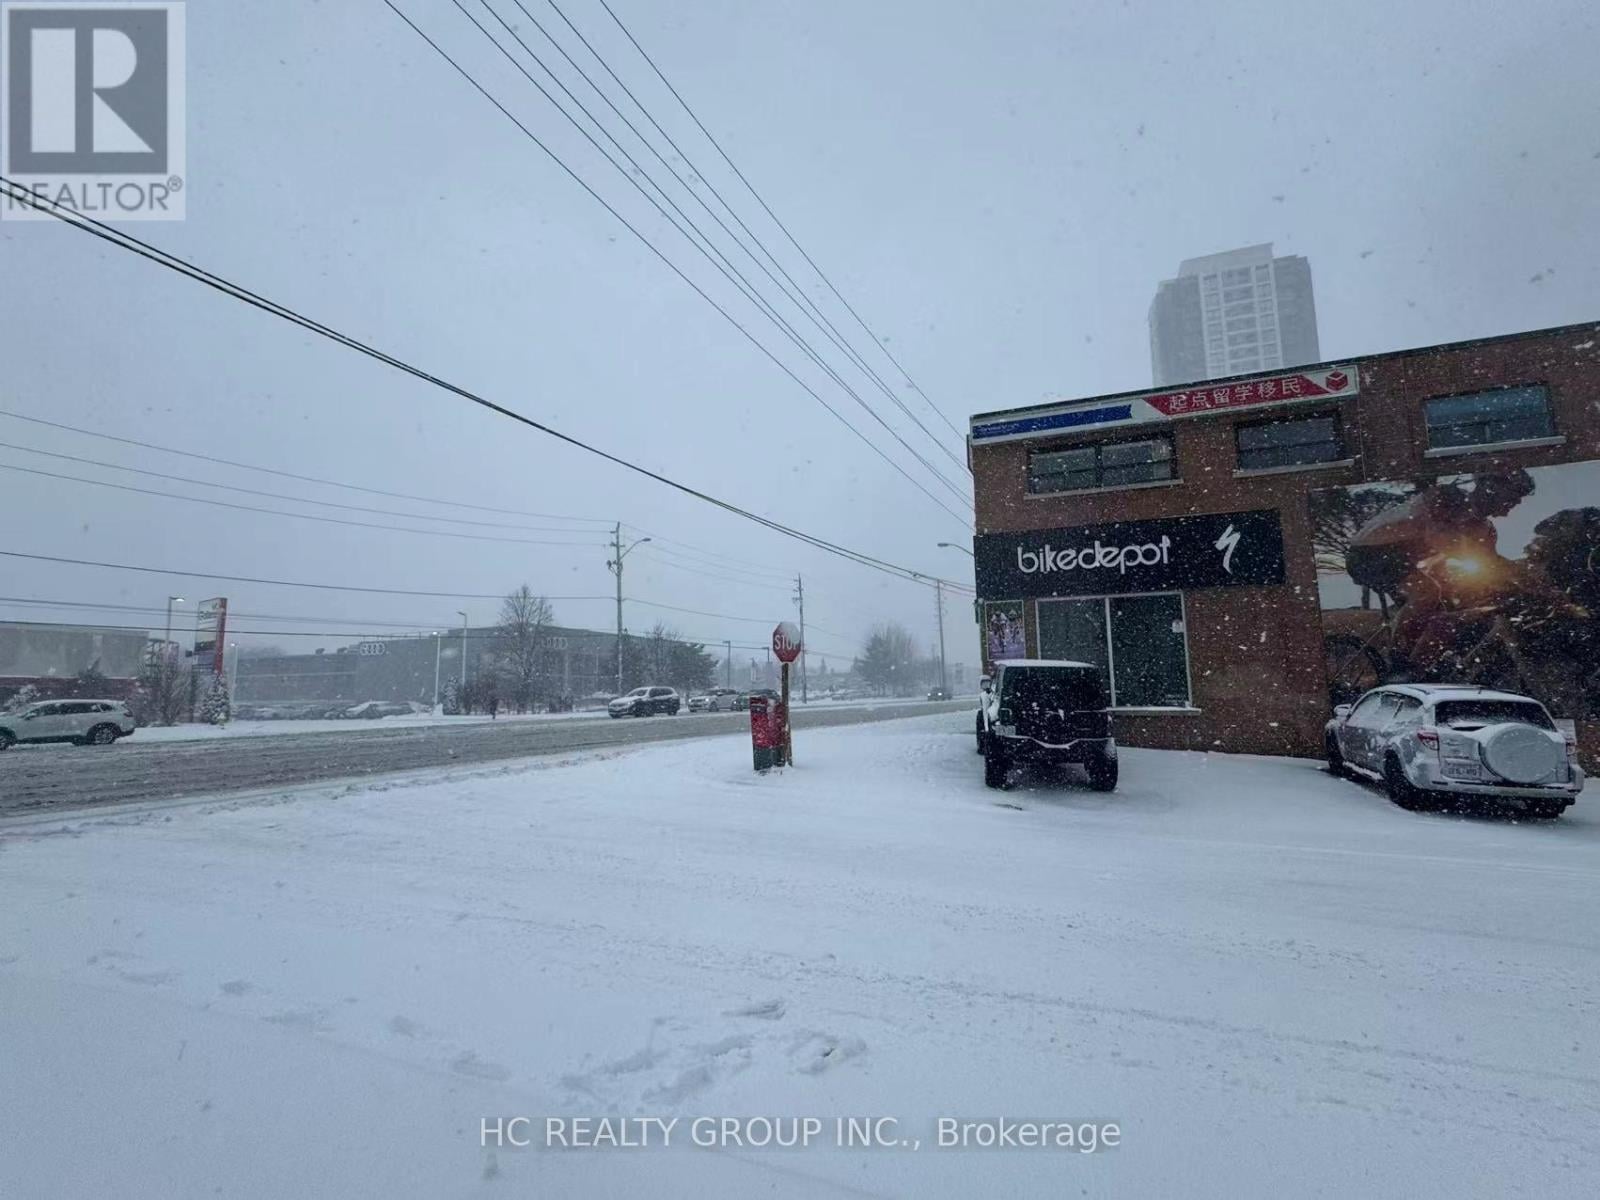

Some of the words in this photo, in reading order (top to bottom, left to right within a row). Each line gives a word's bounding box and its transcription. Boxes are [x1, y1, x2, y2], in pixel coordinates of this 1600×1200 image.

[1168, 378, 1302, 412] 起点留学移民
